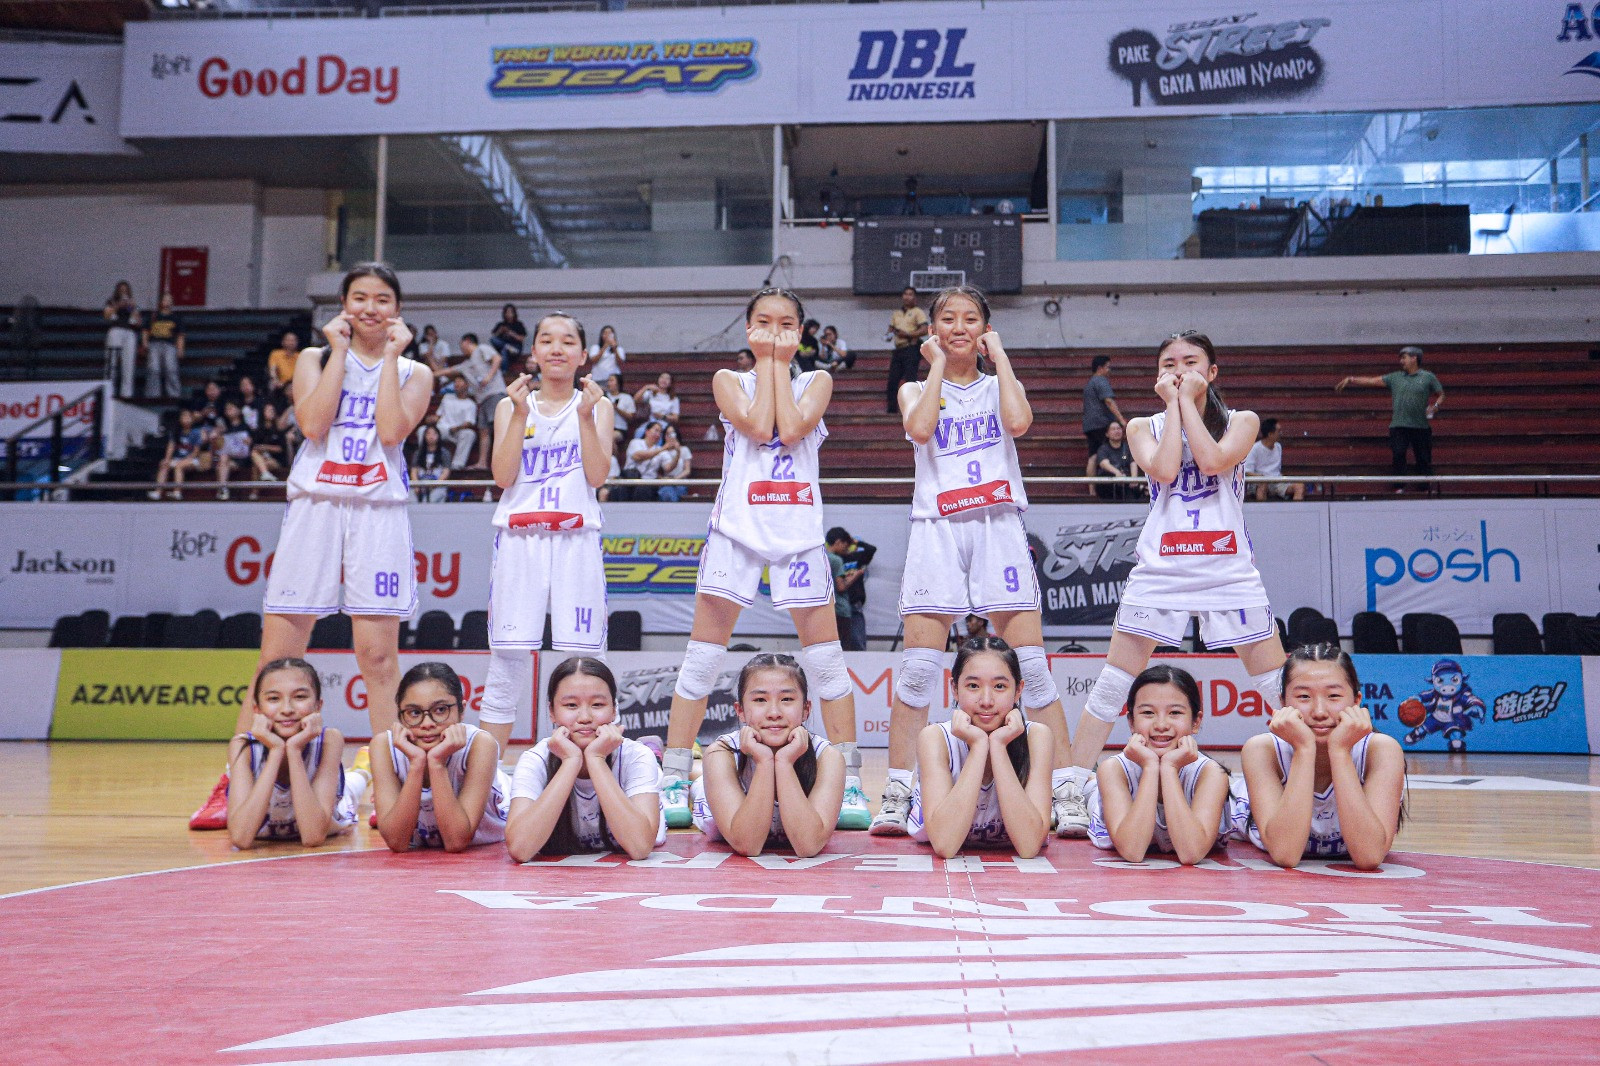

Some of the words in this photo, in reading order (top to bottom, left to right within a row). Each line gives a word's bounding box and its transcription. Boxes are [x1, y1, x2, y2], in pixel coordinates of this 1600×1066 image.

[848, 28, 975, 79] DBL
[1118, 46, 1150, 64] PAKE
[1156, 18, 1331, 70] STREET
[199, 56, 307, 98] Good
[316, 55, 399, 104] Day
[848, 82, 975, 101] INDONESIA
[1159, 73, 1195, 96] GAYA
[1200, 67, 1246, 91] MAKIN
[935, 414, 1002, 449] VITA
[341, 436, 368, 462] 88
[522, 443, 582, 476] VITA
[771, 454, 795, 480] 22
[966, 460, 982, 485] 9
[538, 487, 560, 509] 14
[751, 493, 766, 502] One
[941, 503, 958, 512] One
[1186, 510, 1200, 530] 7
[1421, 525, 1476, 543] ポッシュ
[10, 550, 116, 574] Jackson
[1161, 544, 1175, 553] One
[788, 561, 811, 588] 22
[1003, 565, 1020, 593] 9
[1364, 519, 1521, 612] posh
[375, 571, 399, 598] 88
[1047, 585, 1086, 611] GAYA
[574, 606, 592, 633] 14
[1494, 682, 1566, 720] 遊ぼう!
[436, 889, 1592, 928] HONDA
